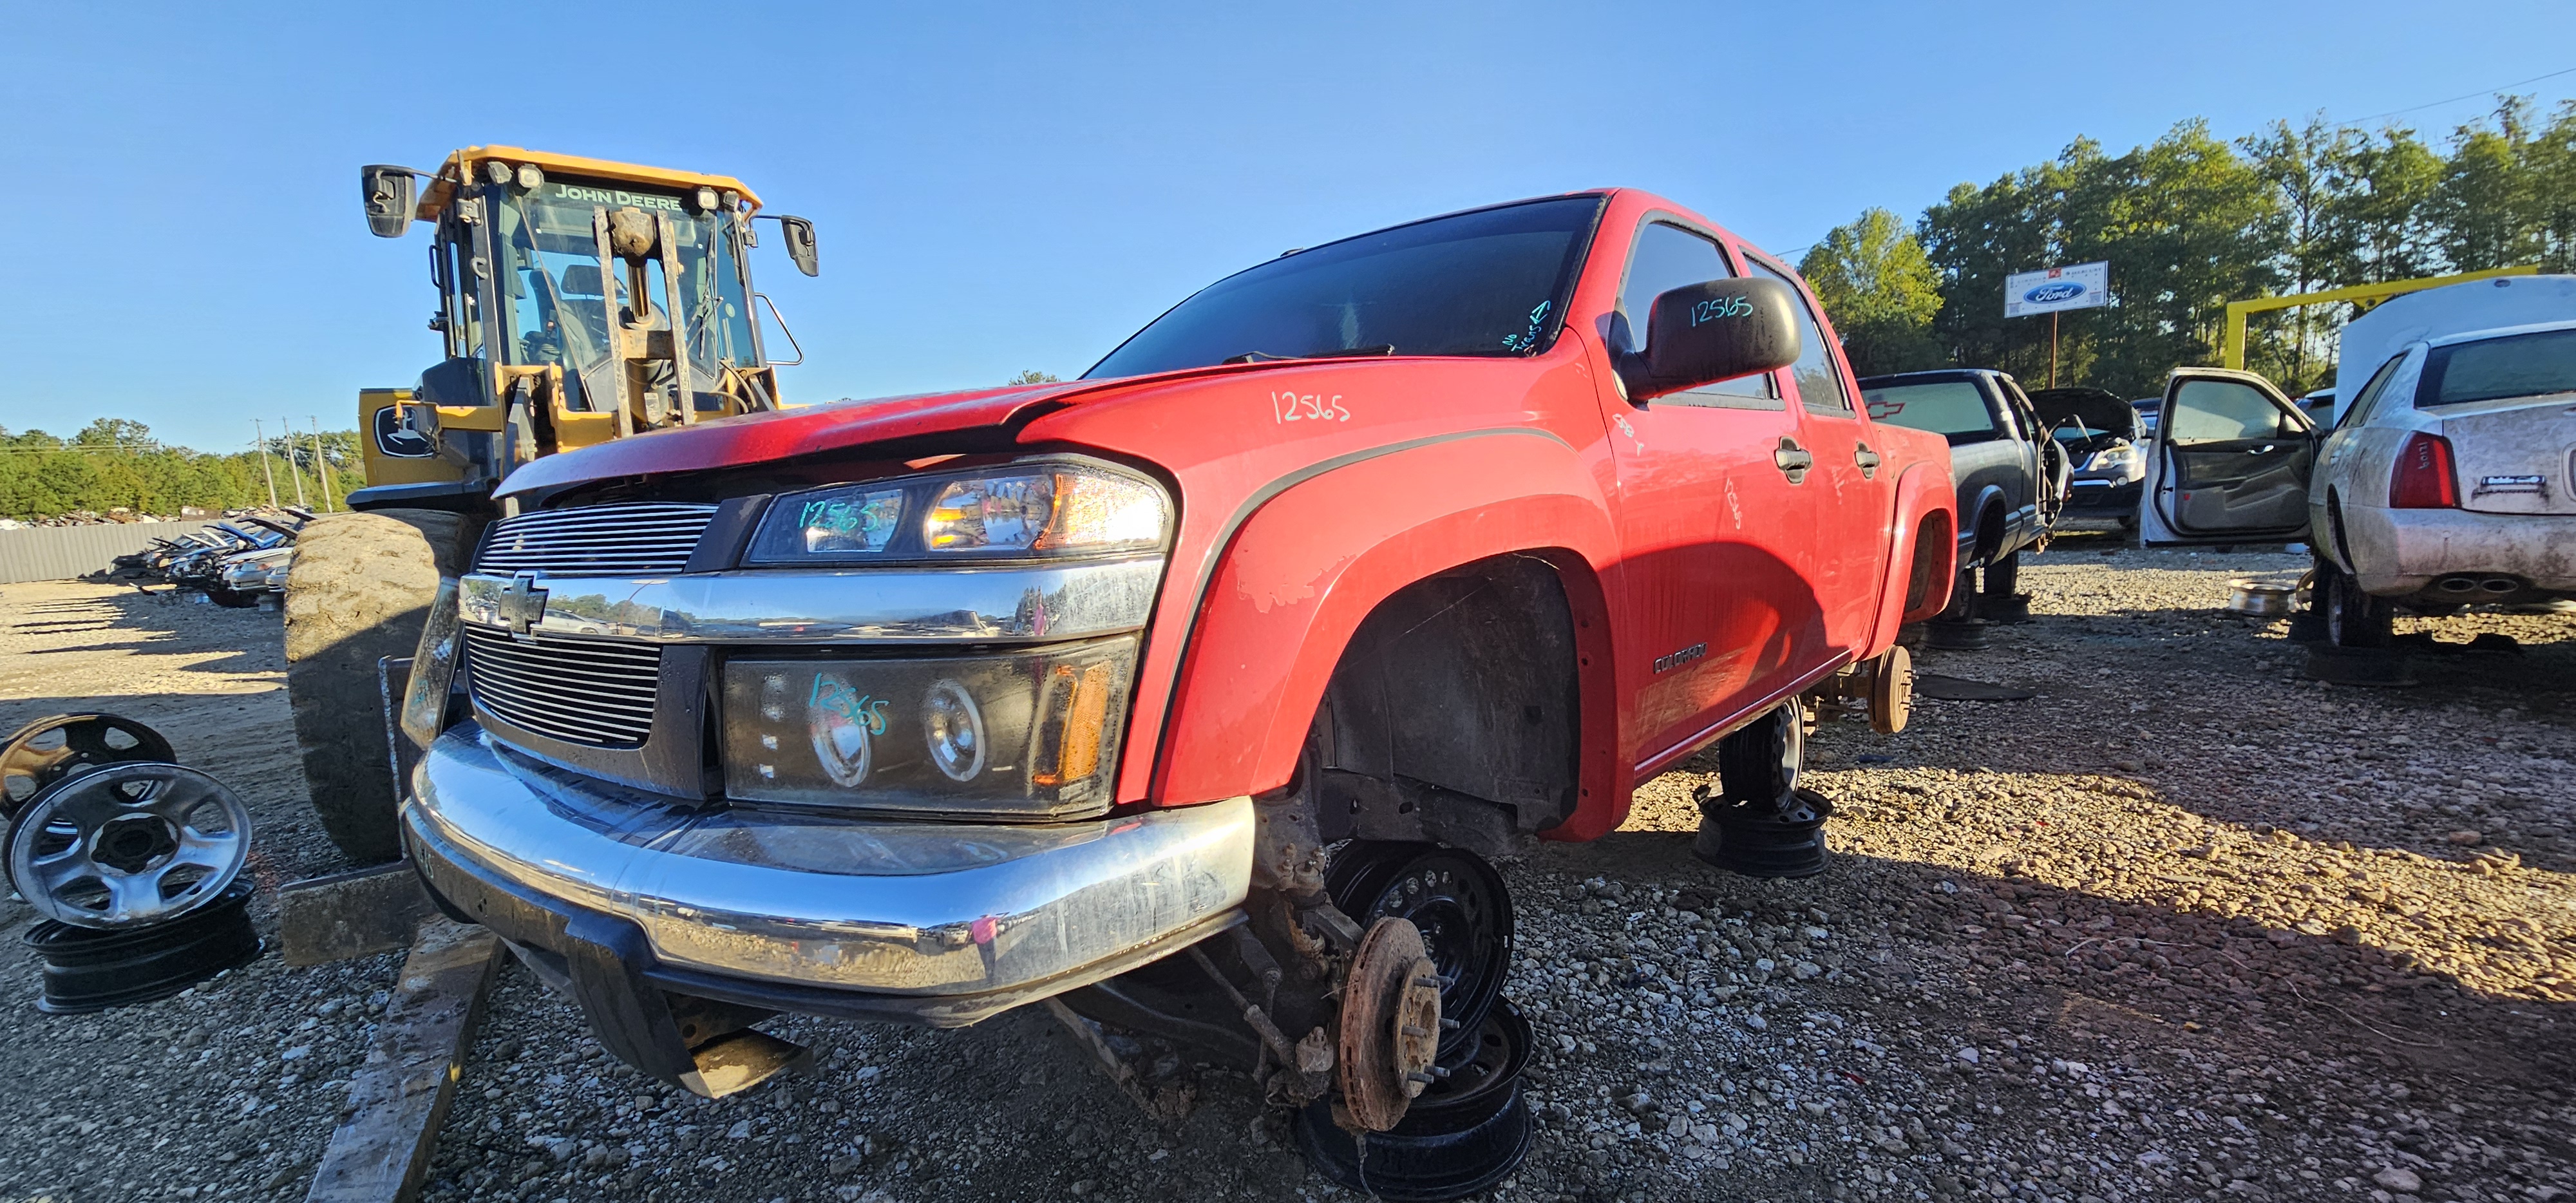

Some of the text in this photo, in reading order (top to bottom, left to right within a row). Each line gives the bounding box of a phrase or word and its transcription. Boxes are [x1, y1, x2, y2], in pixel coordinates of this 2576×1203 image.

[555, 184, 683, 211] JOHN DEERE
[2035, 285, 2074, 302] Ford
[1691, 296, 1754, 327] 12565
[1271, 391, 1350, 424] 12565
[799, 501, 880, 534] 12565
[809, 672, 889, 735] 12565
